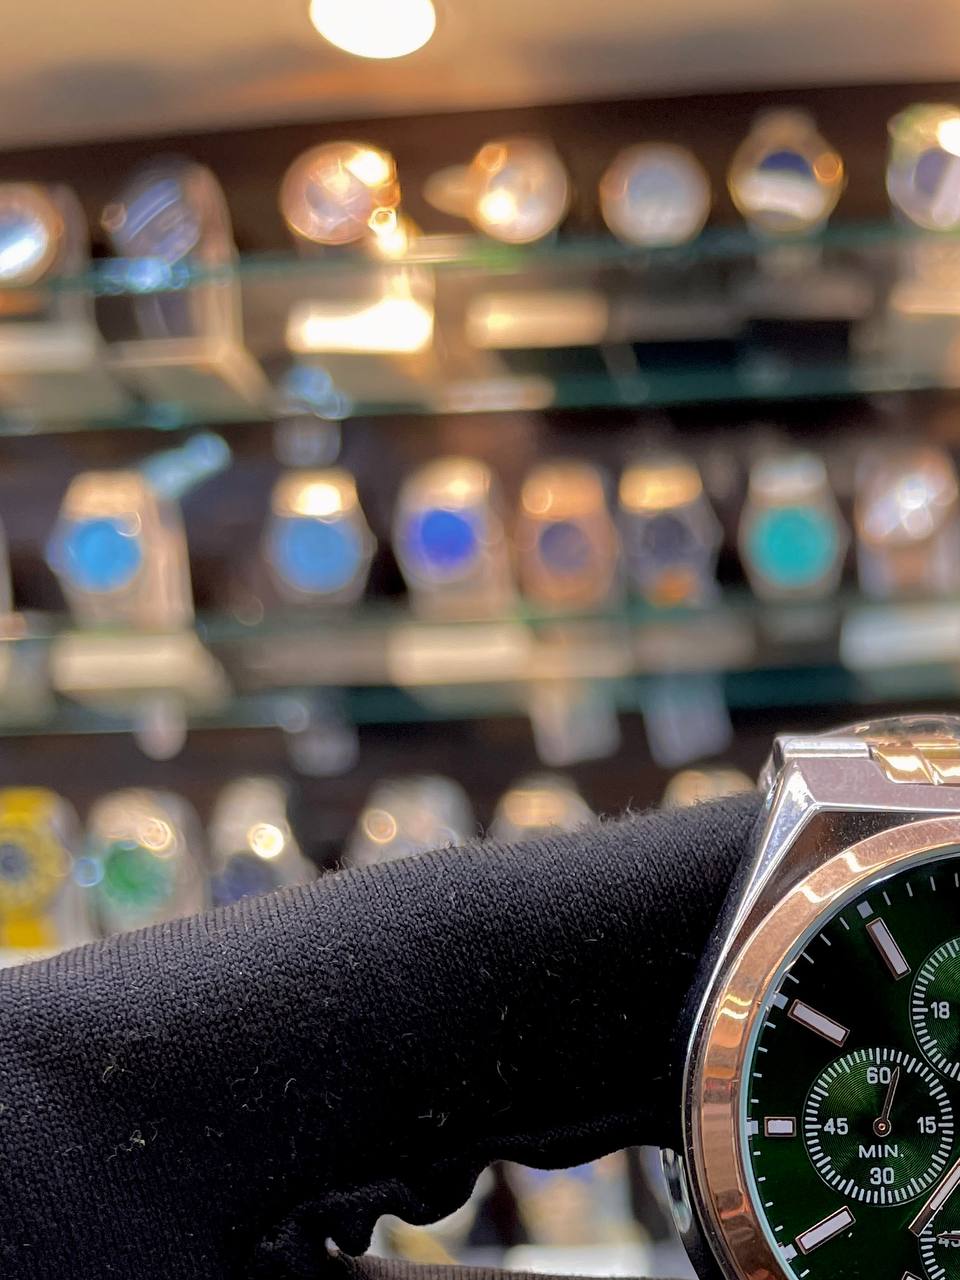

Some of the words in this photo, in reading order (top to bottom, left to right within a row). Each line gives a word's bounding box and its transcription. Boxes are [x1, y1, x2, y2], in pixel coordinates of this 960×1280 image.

[930, 1001, 950, 1019] 18
[866, 1066, 891, 1084] 60
[823, 1117, 849, 1135] 45
[917, 1116, 937, 1134] 15
[858, 1144, 905, 1158] MIN.
[870, 1167, 894, 1185] 30
